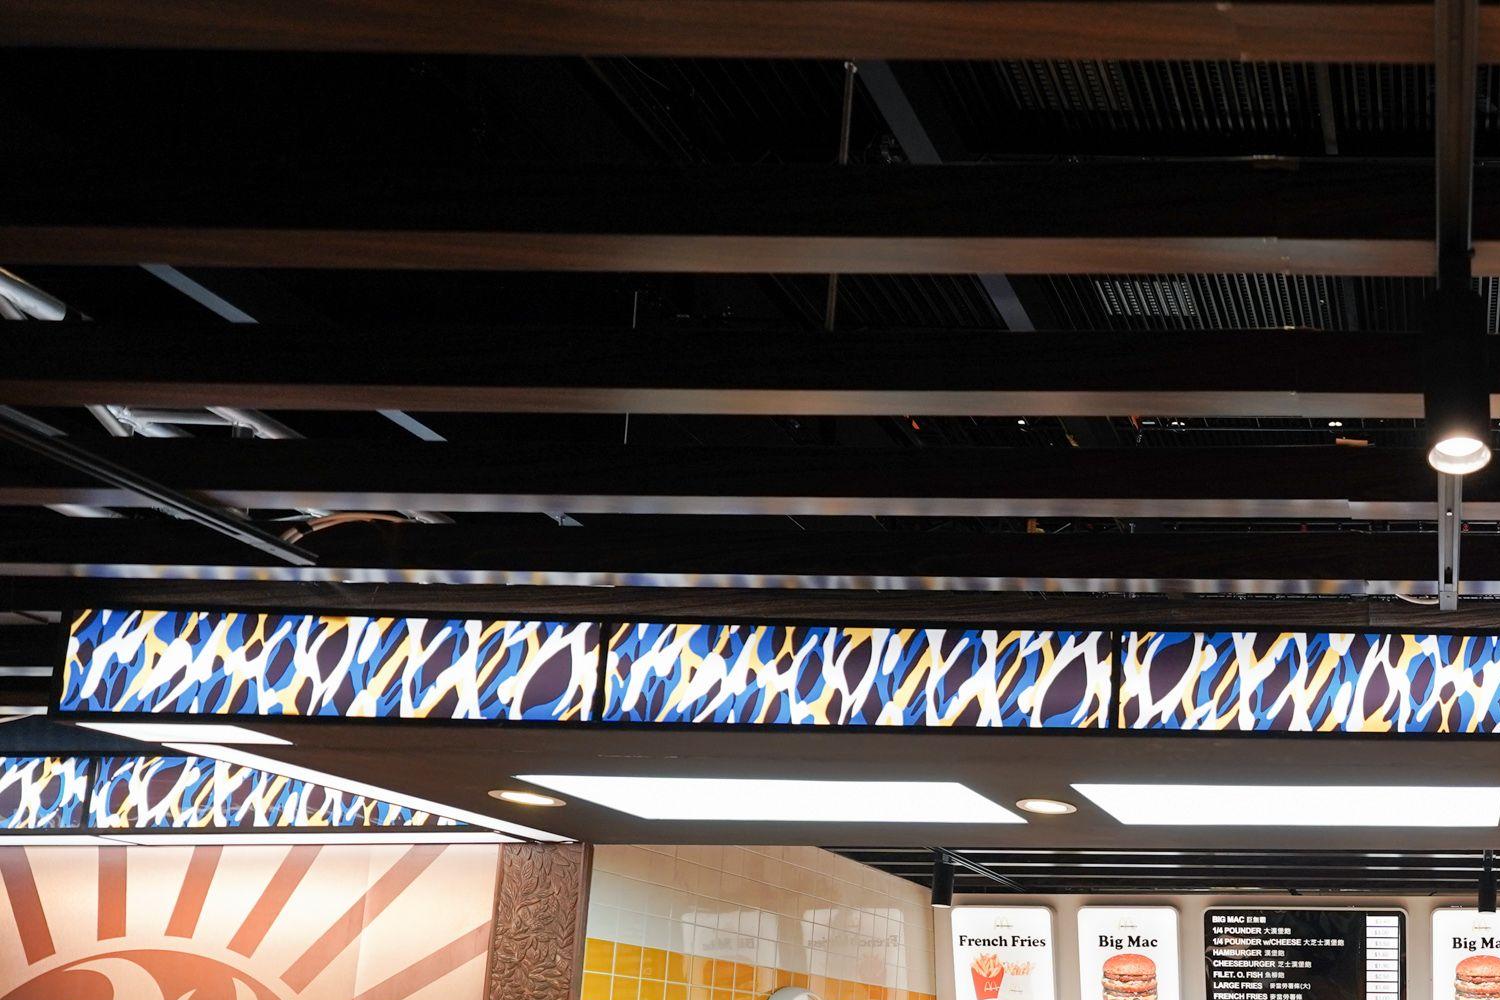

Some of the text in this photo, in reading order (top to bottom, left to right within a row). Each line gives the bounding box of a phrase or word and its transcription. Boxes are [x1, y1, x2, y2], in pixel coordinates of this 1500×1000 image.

[958, 934, 1046, 948] French Fries
[1098, 935, 1158, 950] Big Mac
[1212, 938, 1223, 946] 1/4
[1224, 938, 1262, 946] POUNDER
[1263, 938, 1302, 946] w/CHEESE
[1452, 937, 1477, 952] Big
[1212, 949, 1262, 957] HAMBURGER
[1213, 960, 1276, 968] CHEESEBURGER
